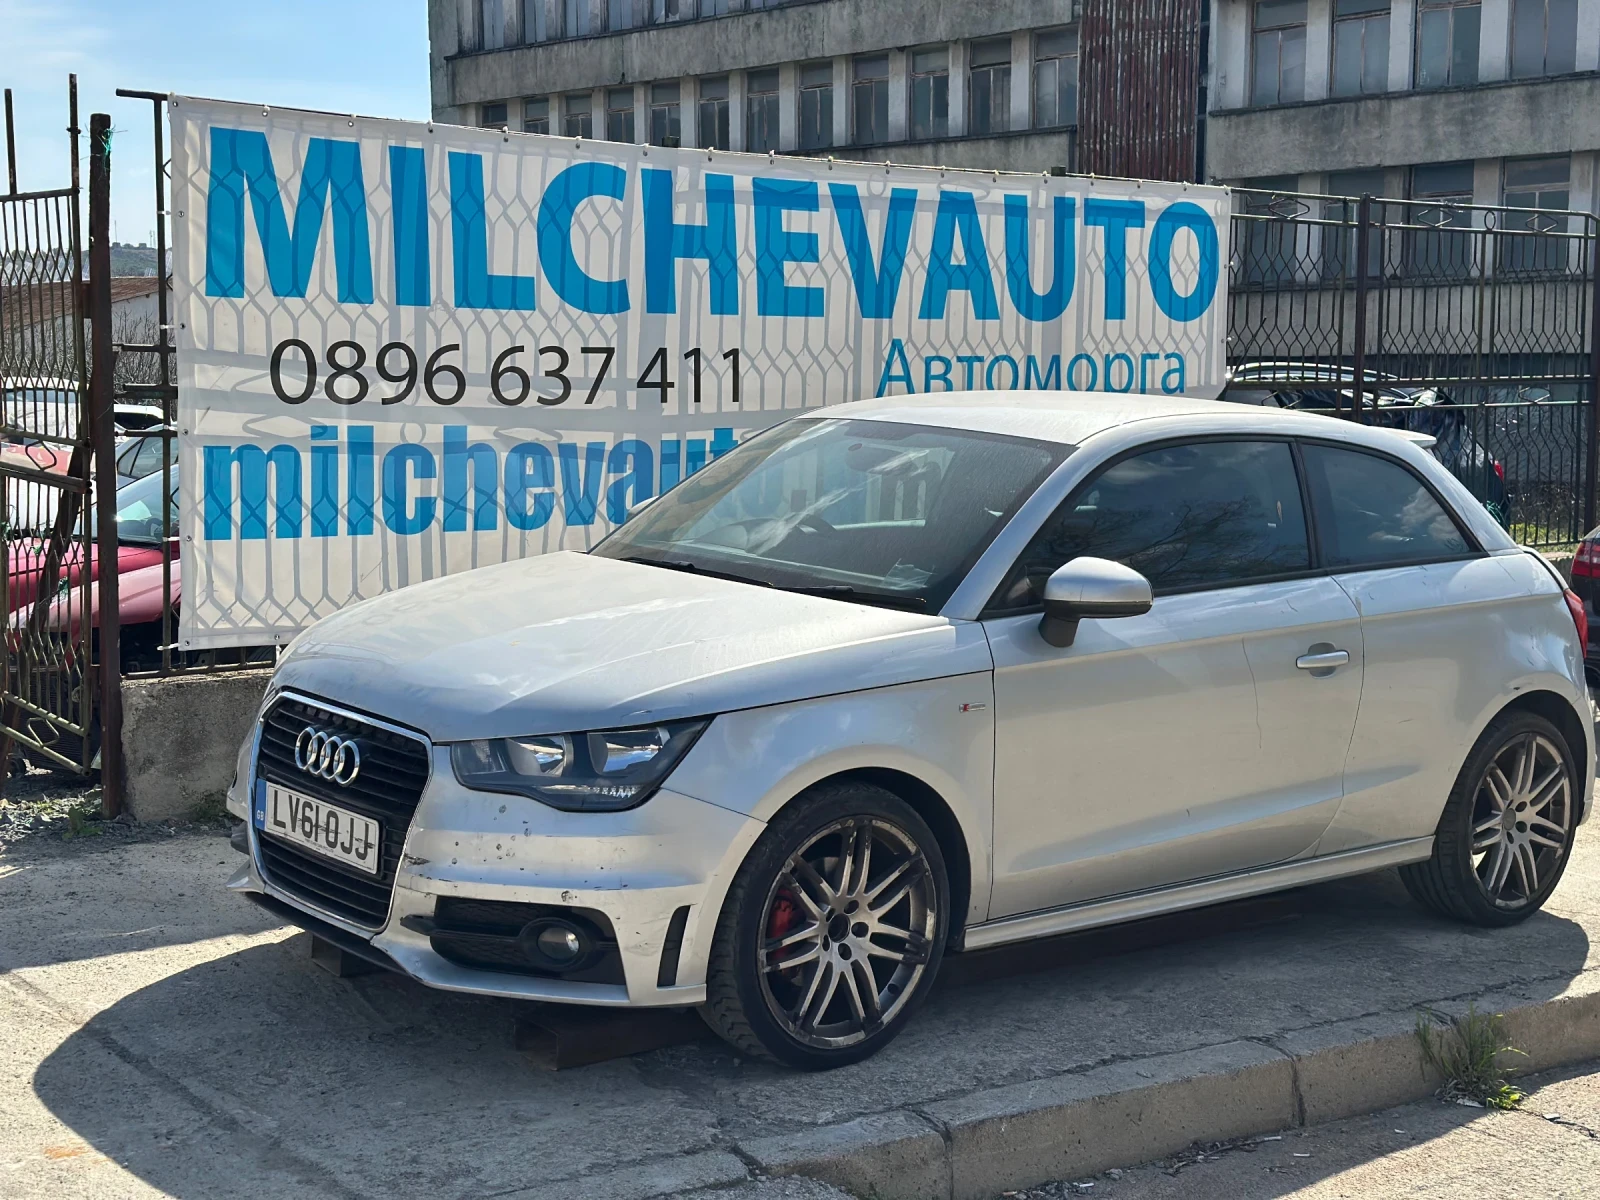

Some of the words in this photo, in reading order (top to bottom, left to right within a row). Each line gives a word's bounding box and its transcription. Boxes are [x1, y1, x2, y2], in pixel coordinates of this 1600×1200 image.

[205, 126, 1219, 322] MILCHEVAUTO
[269, 338, 467, 405] 0896
[490, 344, 616, 405] 637
[636, 346, 742, 403] 411
[876, 338, 1186, 399] Автоморга
